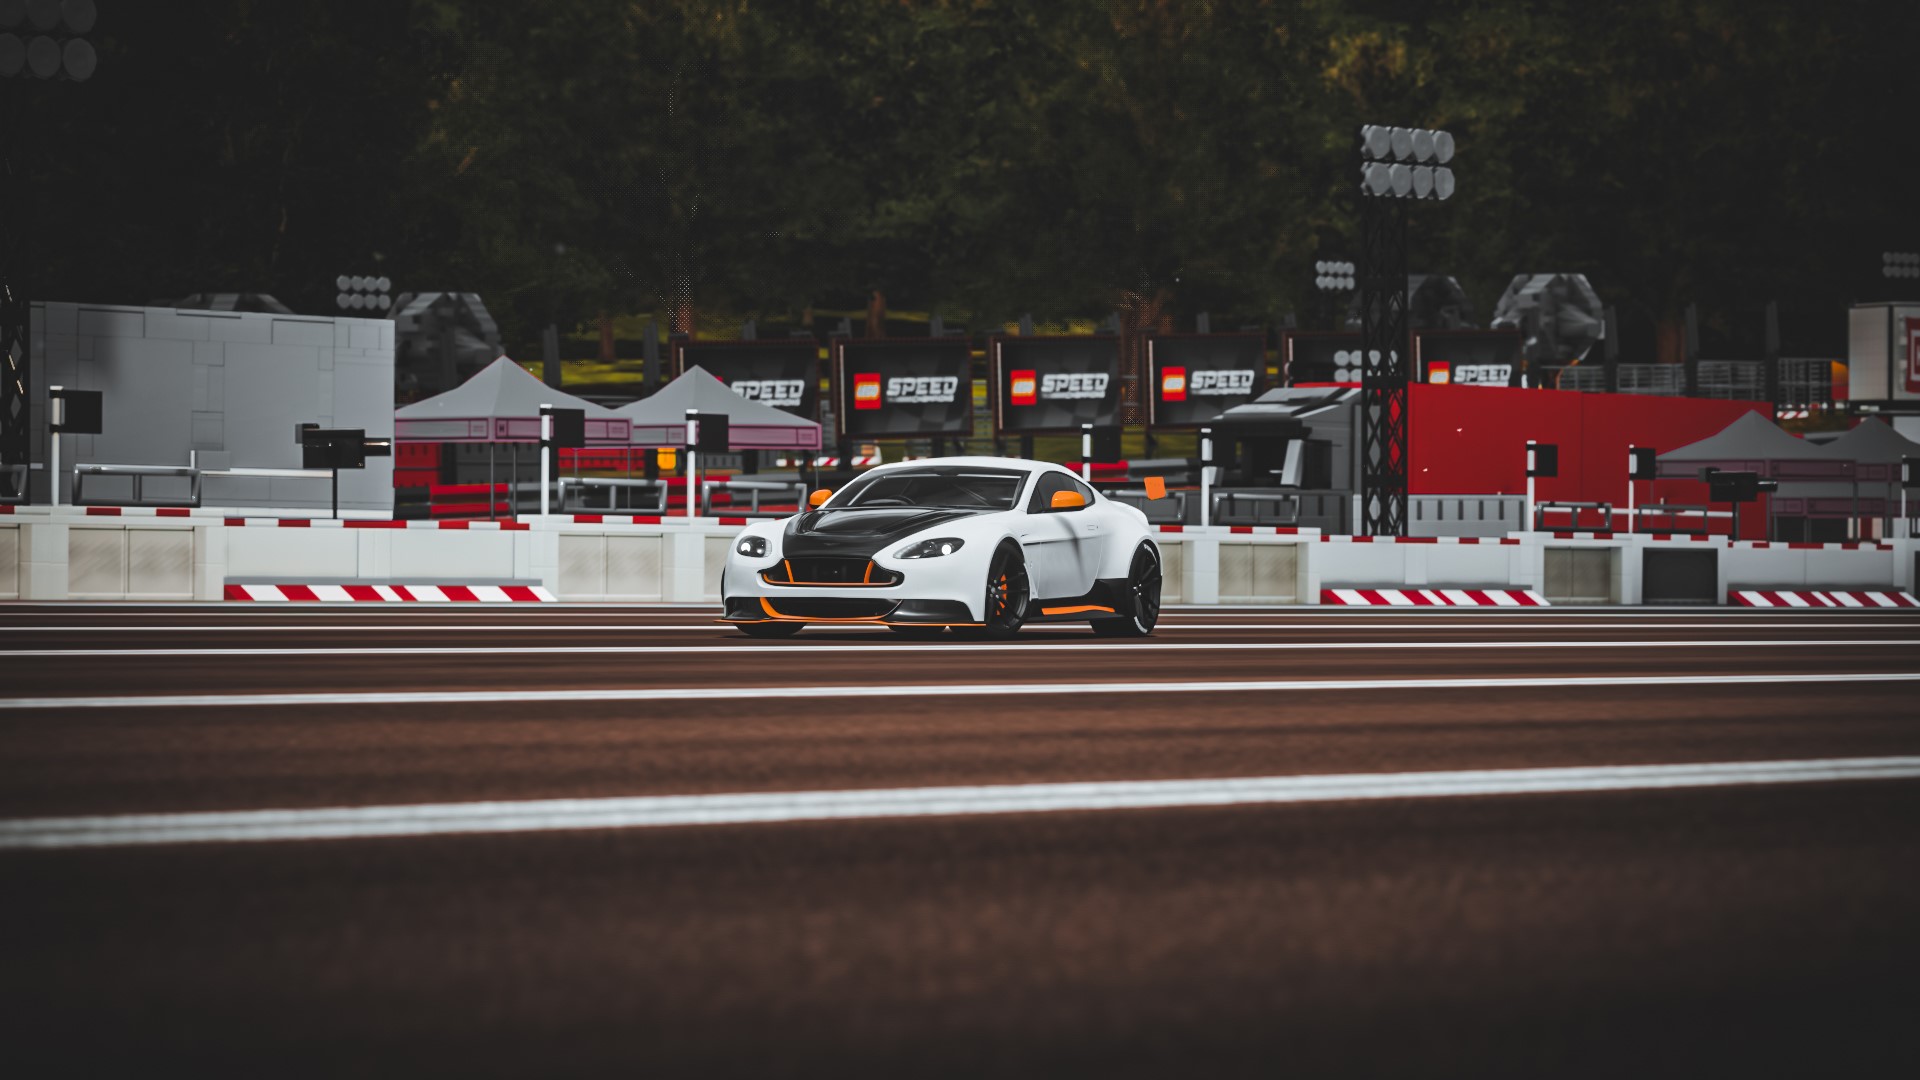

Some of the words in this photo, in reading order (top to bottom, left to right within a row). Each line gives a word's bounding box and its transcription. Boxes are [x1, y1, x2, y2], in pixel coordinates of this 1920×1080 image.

[1041, 373, 1109, 393] SPEED
[1190, 370, 1255, 389] SPEED
[1454, 364, 1512, 383] SPEED
[886, 376, 958, 396] SPEED
